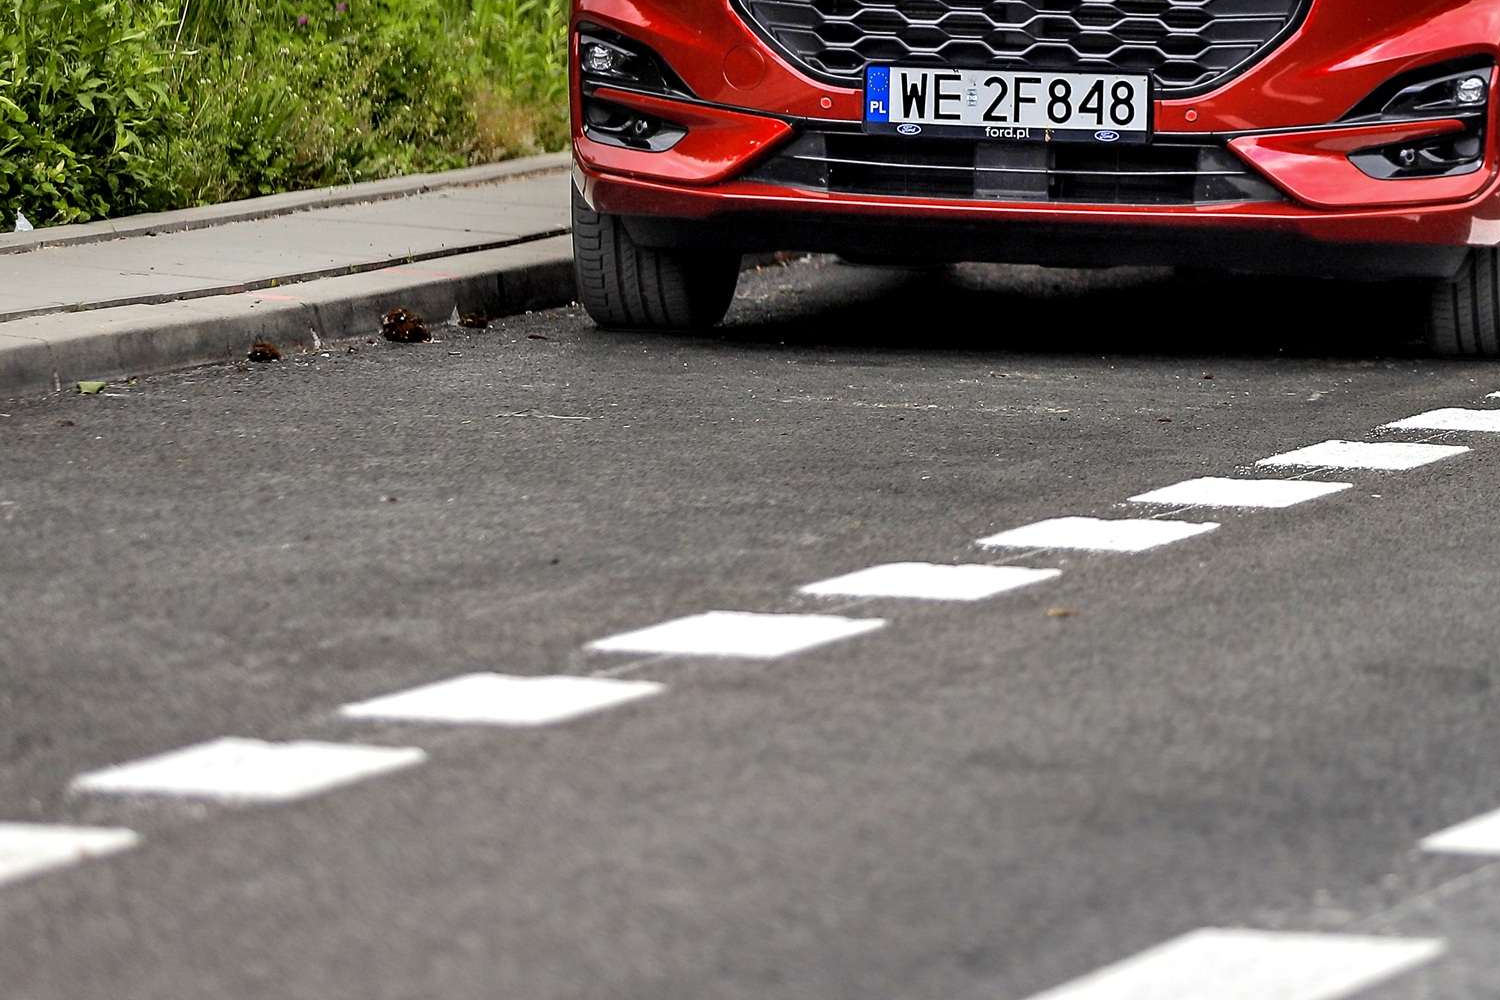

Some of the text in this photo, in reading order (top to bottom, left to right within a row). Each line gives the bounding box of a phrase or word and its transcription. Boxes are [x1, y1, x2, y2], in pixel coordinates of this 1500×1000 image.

[900, 72, 1135, 126] WE 2F848
[870, 100, 887, 114] PL
[985, 126, 1030, 140] ford.pl
